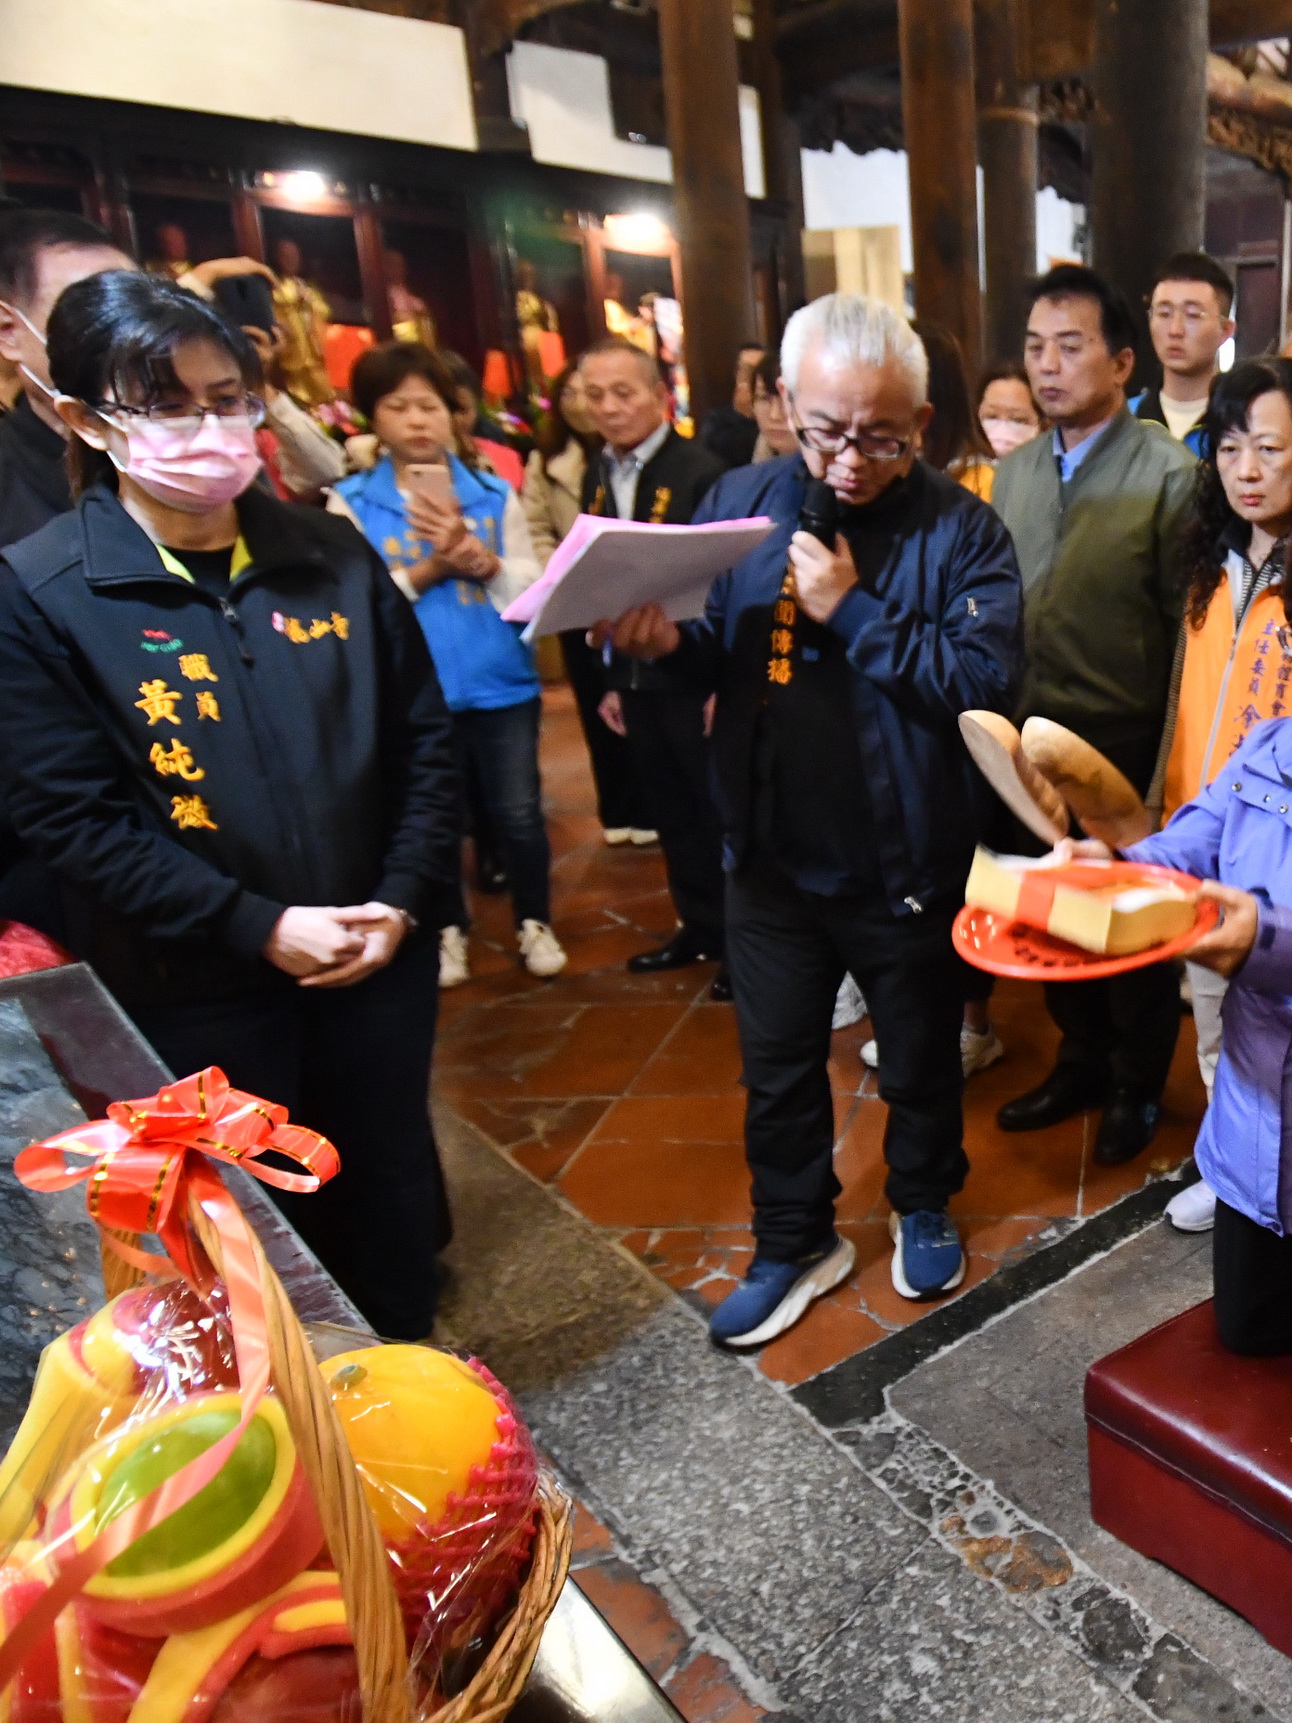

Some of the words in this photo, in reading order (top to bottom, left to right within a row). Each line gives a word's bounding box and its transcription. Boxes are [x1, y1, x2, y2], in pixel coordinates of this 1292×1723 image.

[178, 653, 221, 722] 職員
[1248, 618, 1276, 697] 主任委員
